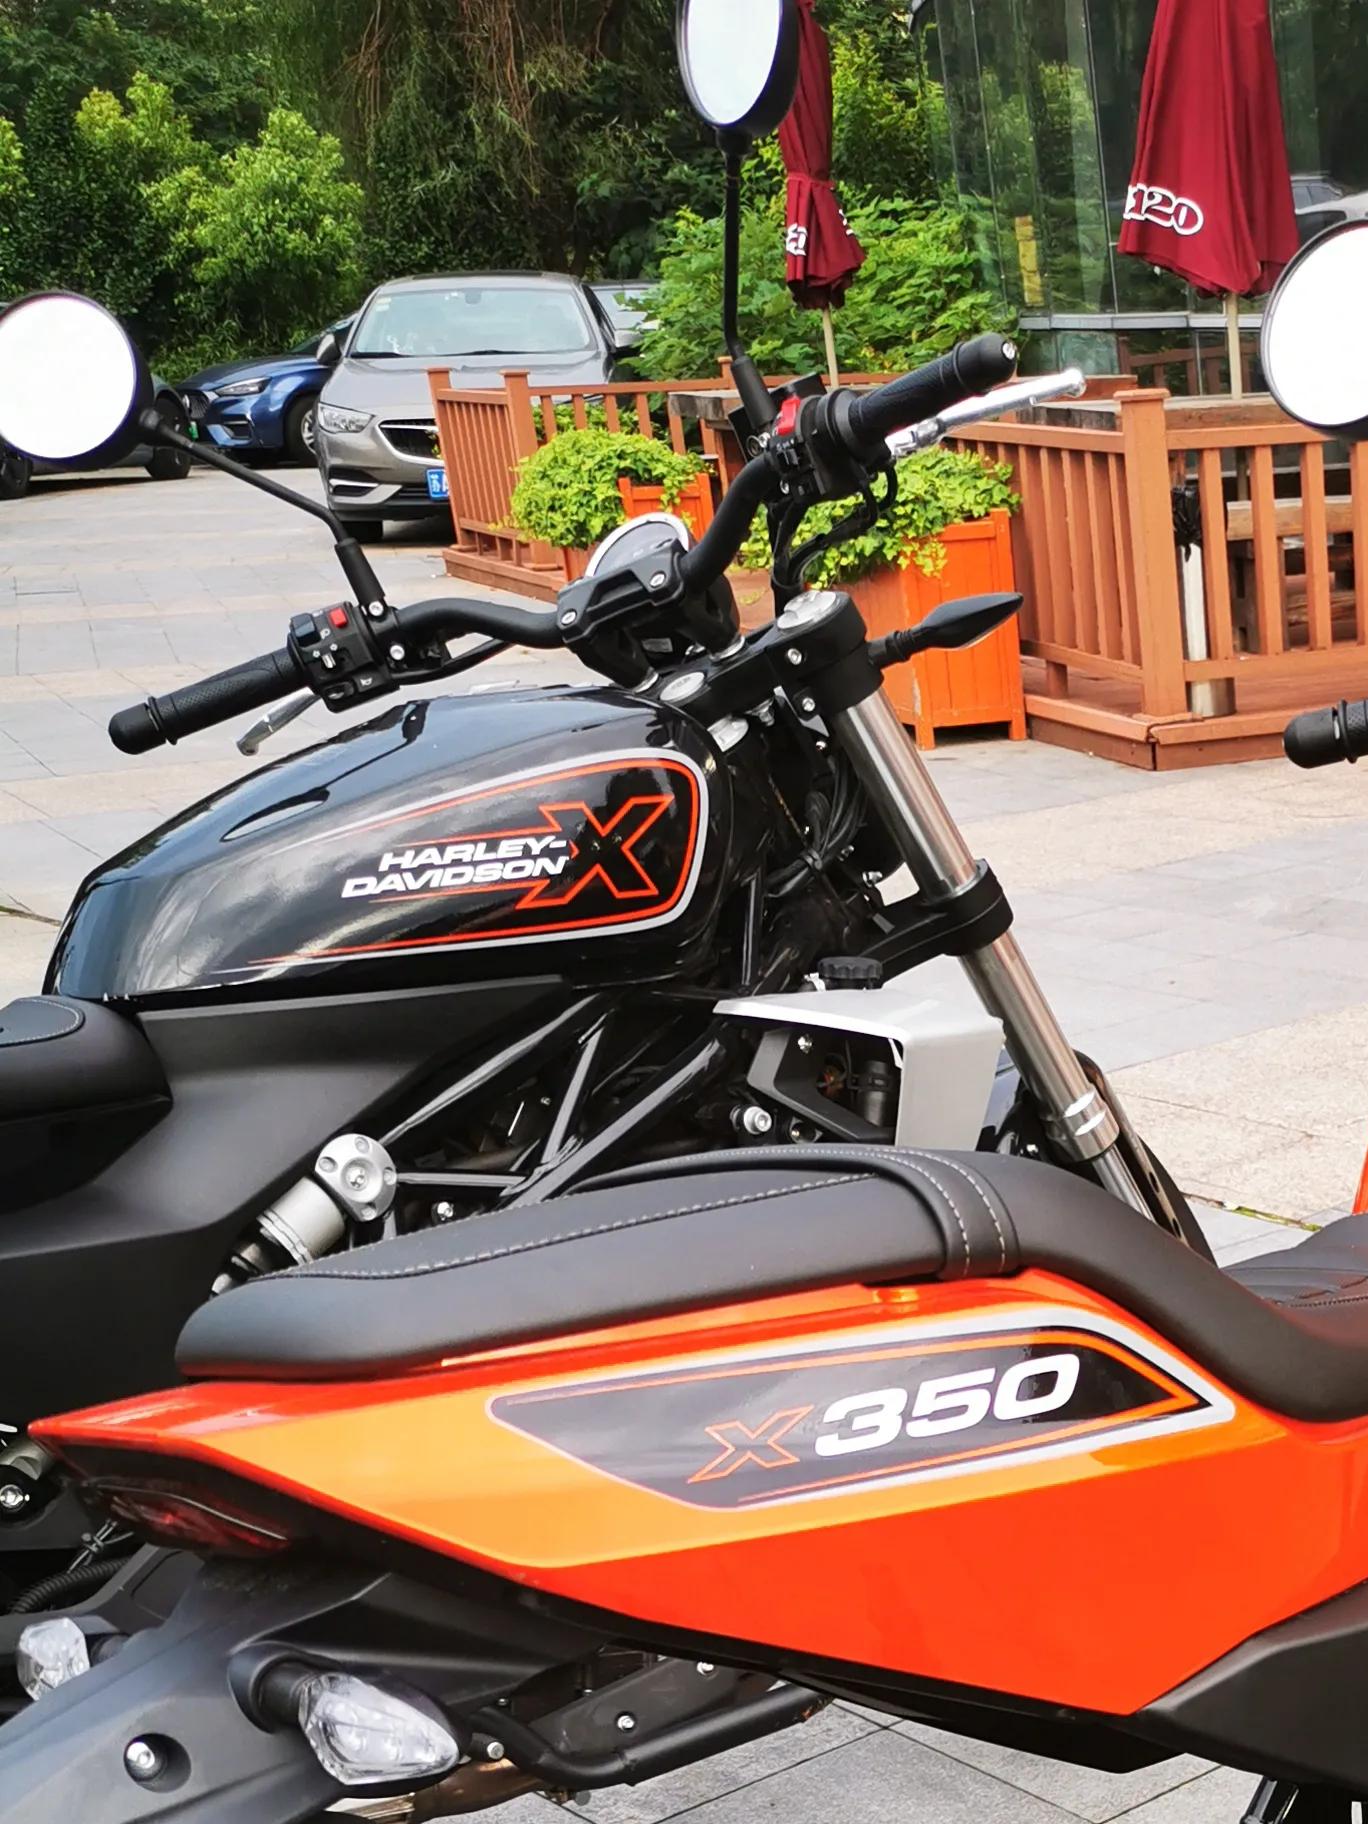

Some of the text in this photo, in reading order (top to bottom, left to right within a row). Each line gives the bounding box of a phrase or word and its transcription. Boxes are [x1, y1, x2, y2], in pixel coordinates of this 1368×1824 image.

[1123, 183, 1204, 235] 120
[377, 835, 568, 872] HARLEY-
[341, 856, 570, 898] DAVIDSON
